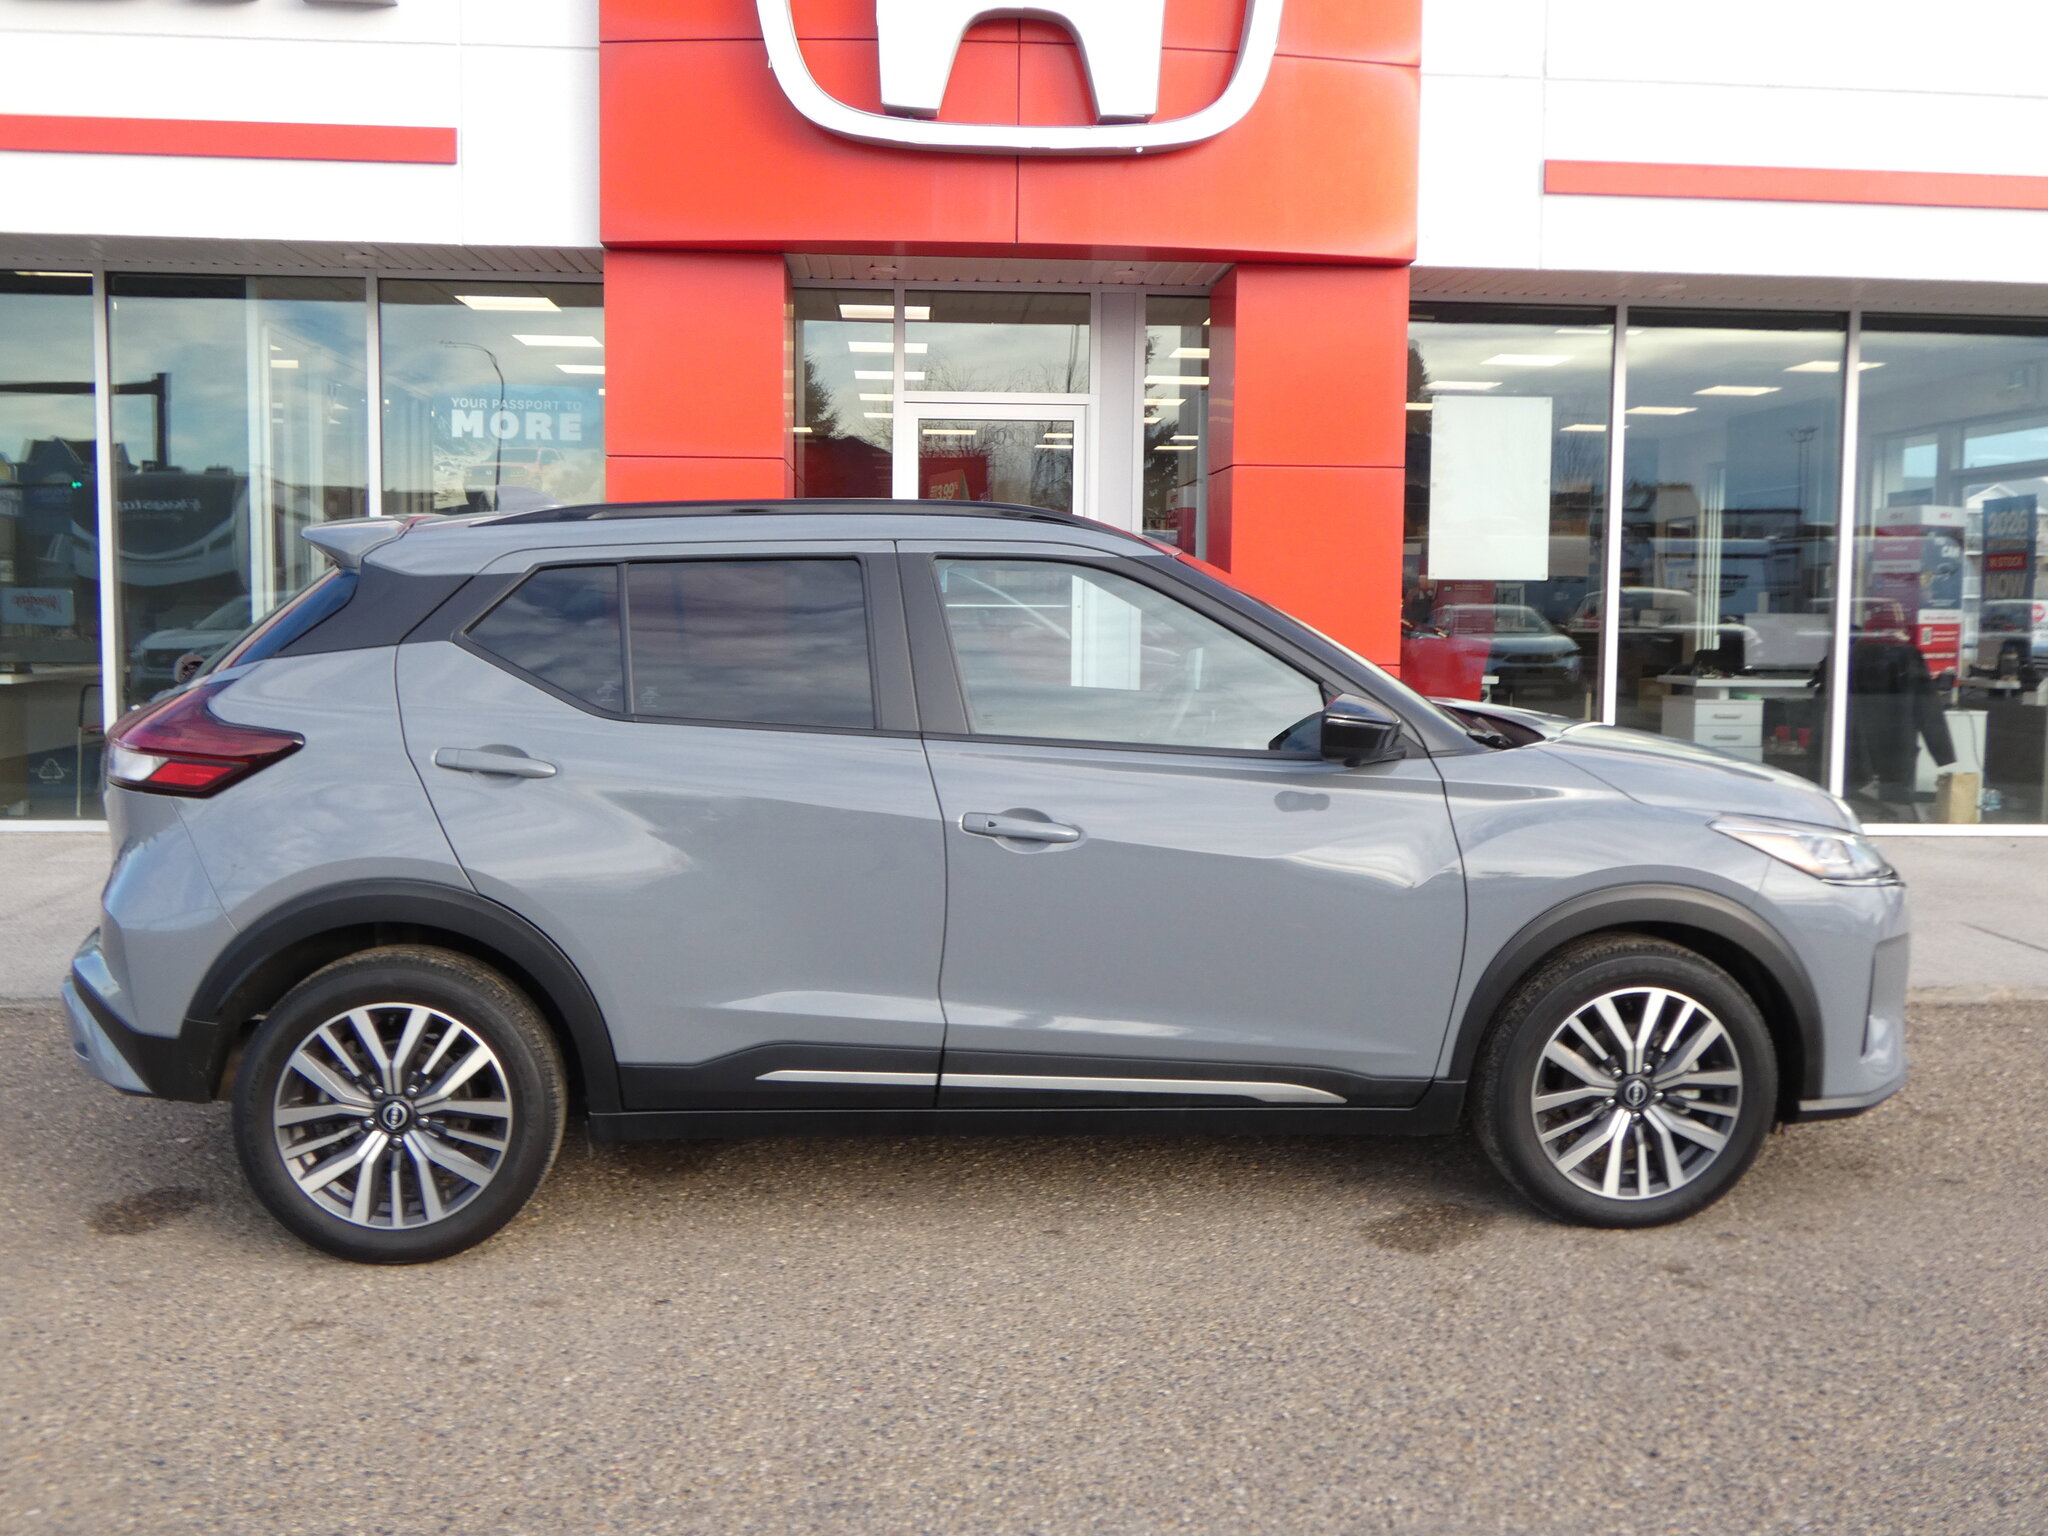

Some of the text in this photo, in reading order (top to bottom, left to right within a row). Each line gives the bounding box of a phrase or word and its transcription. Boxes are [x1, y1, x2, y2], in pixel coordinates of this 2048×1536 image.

[451, 397, 582, 411] YOUR PASSPORT TO
[451, 409, 582, 441] MORE
[1988, 510, 2029, 536] 2026
[1986, 574, 2027, 598] NOW
